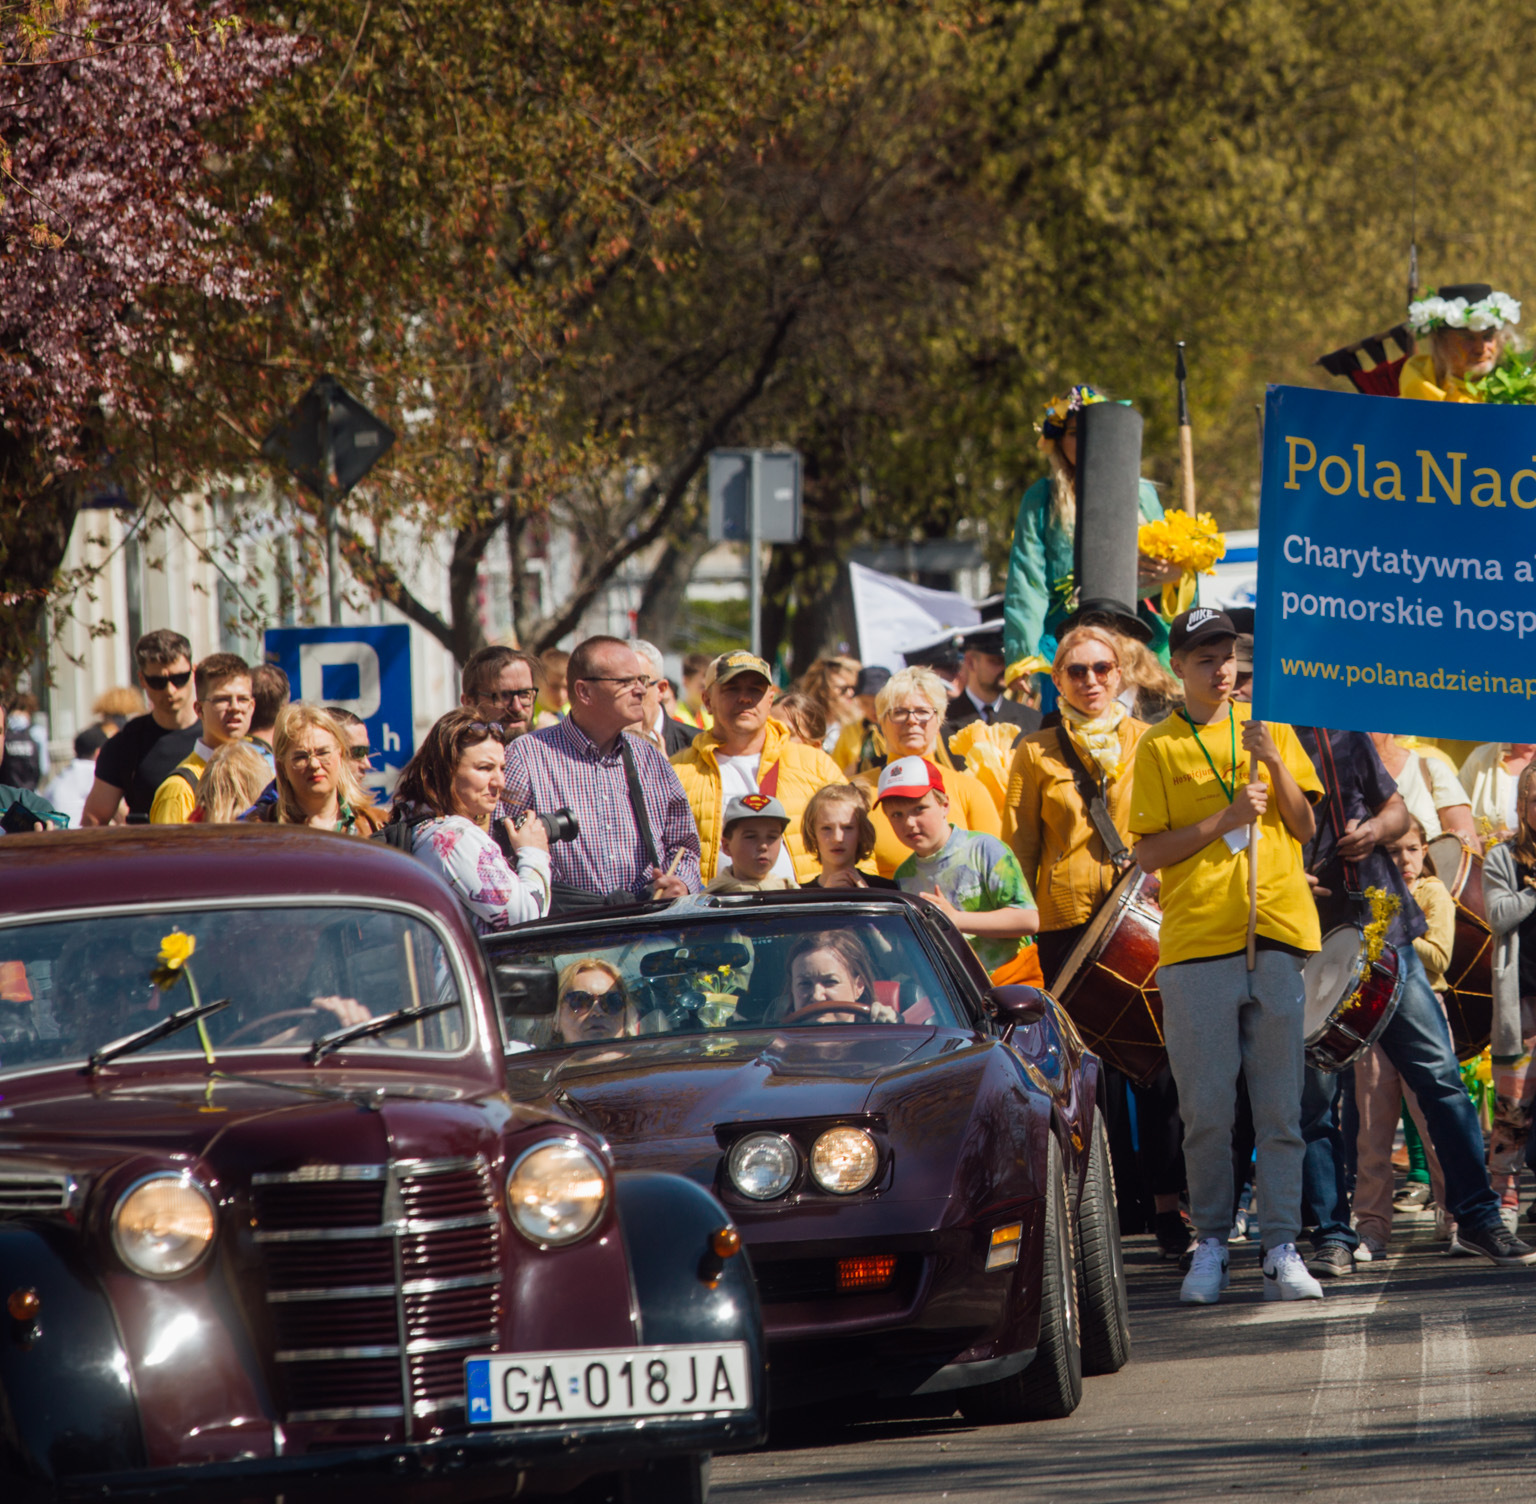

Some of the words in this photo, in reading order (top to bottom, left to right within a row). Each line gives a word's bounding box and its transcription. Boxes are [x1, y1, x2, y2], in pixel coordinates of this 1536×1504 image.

[1283, 435, 1406, 502] Pola
[1282, 534, 1504, 584] Charytatywna
[1188, 609, 1214, 625] NIKE
[1280, 591, 1444, 628] pomorskie
[471, 1397, 491, 1413] PL
[503, 1365, 564, 1413] GA
[584, 1355, 736, 1409] 018JA
